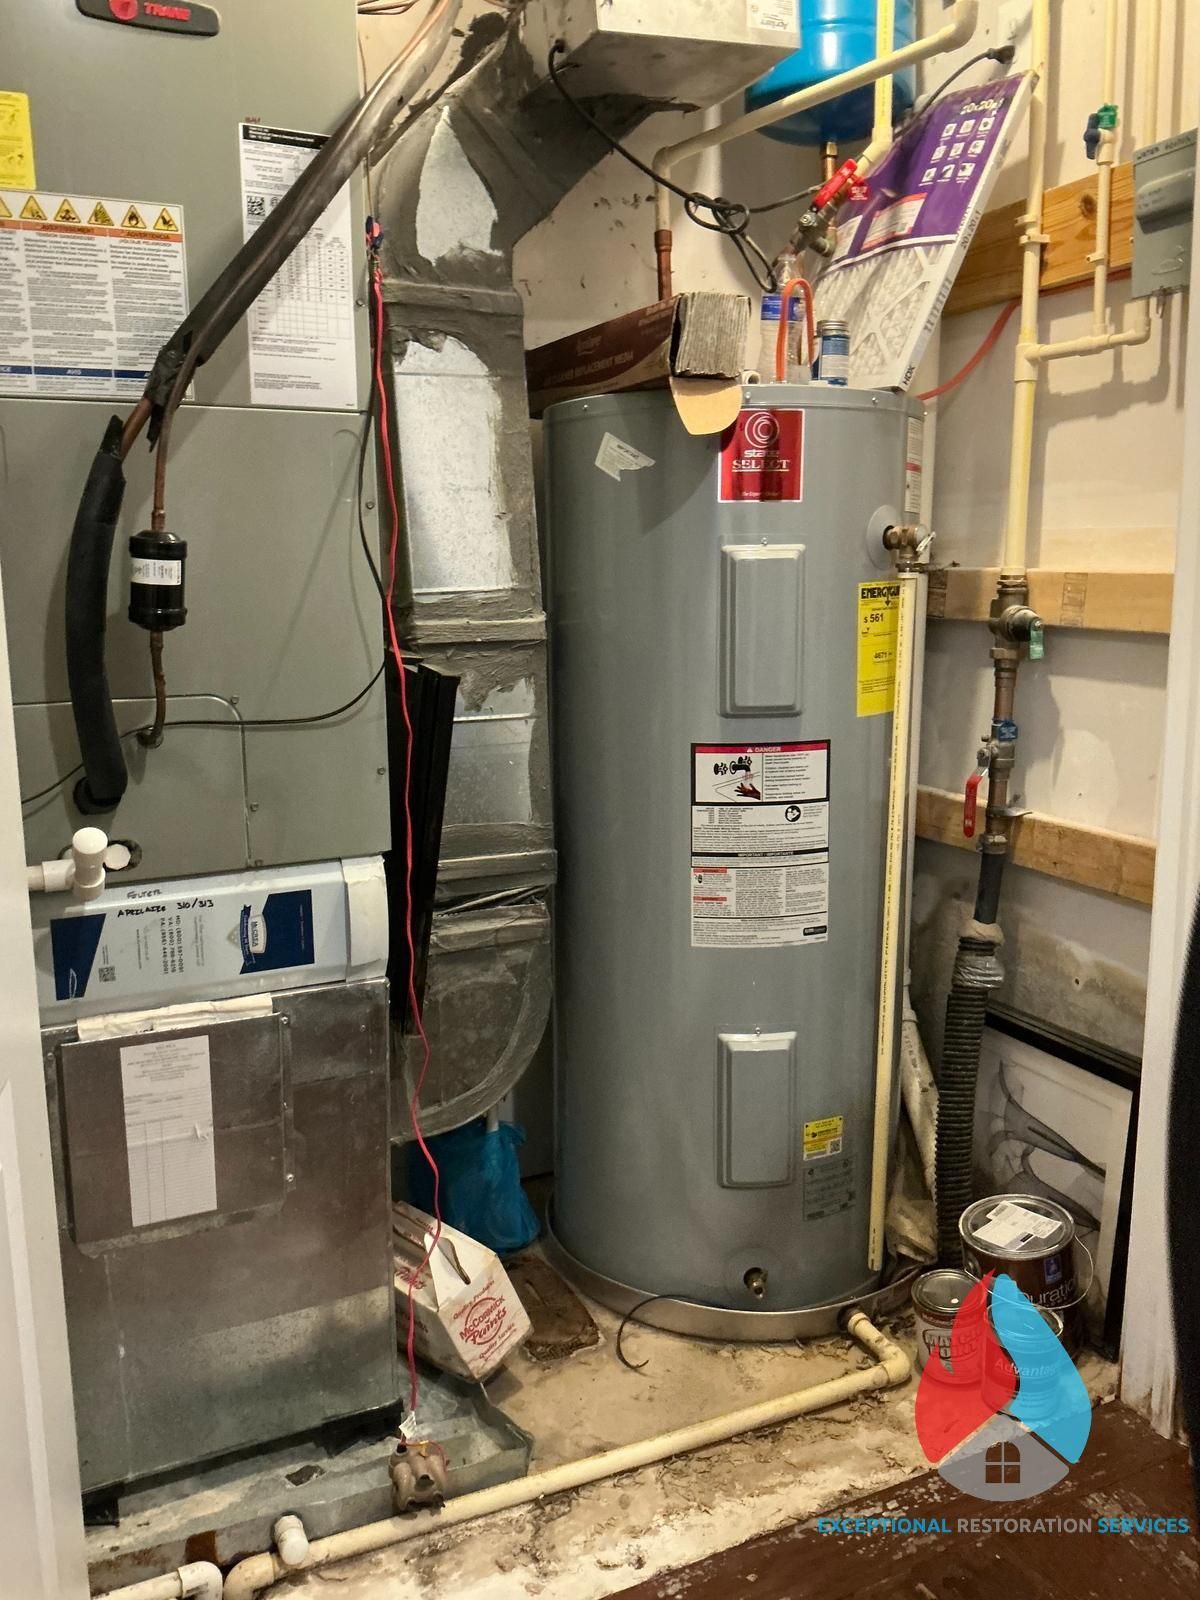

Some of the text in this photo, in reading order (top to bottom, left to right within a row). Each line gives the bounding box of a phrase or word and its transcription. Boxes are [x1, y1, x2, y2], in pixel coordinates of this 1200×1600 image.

[903, 365, 915, 386] HDX
[732, 459, 790, 469] SELECT
[870, 613, 884, 622] 561
